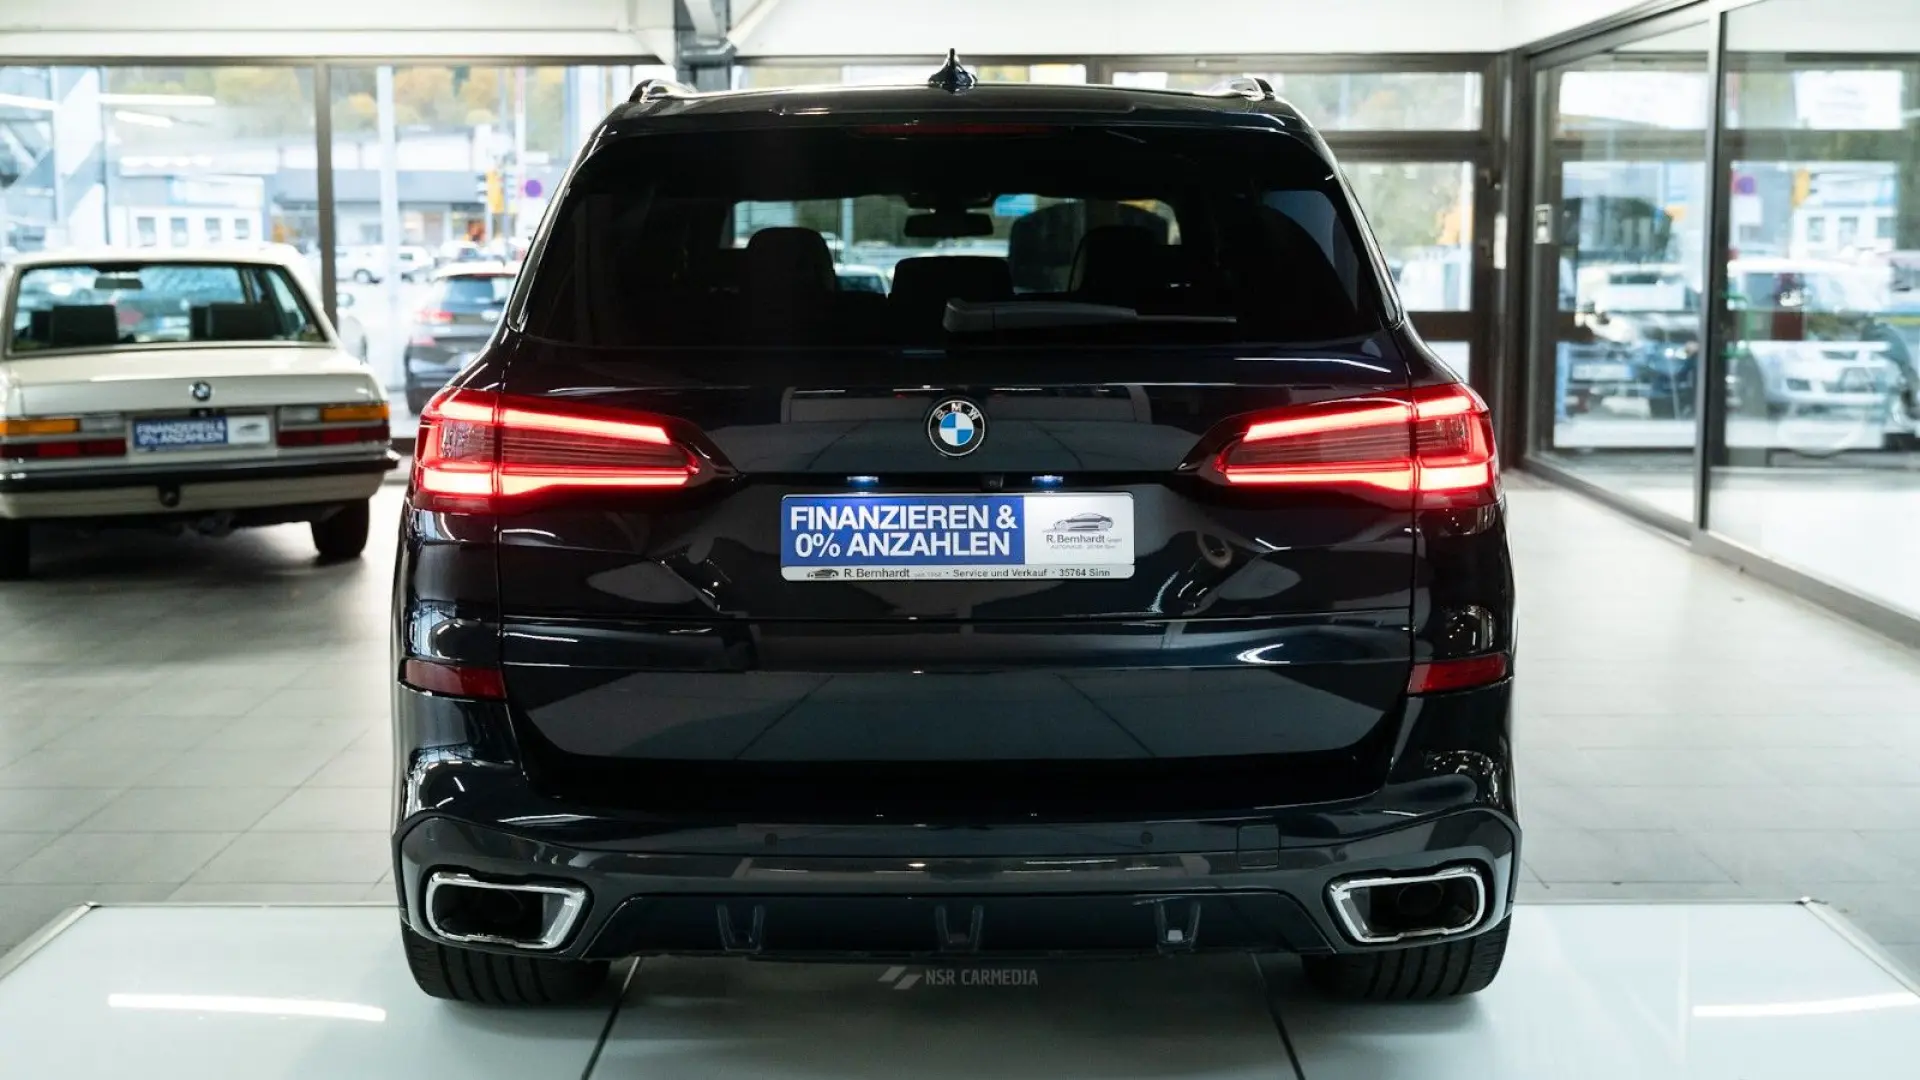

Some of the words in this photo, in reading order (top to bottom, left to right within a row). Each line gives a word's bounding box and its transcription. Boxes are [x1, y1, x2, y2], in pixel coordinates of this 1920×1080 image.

[935, 402, 981, 420] BMW
[790, 505, 989, 530] FINANZIEREN
[996, 504, 1018, 529] &
[795, 532, 840, 557] 0%
[846, 532, 1010, 556] ANZAHLEN
[1057, 534, 1105, 543] Bernhardt
[856, 568, 910, 578] Bernhardt
[953, 569, 988, 577] Service
[991, 569, 1008, 577] und
[1012, 568, 1048, 577] Verkauf
[1059, 568, 1086, 577] 35764
[1089, 568, 1111, 577] Sinn
